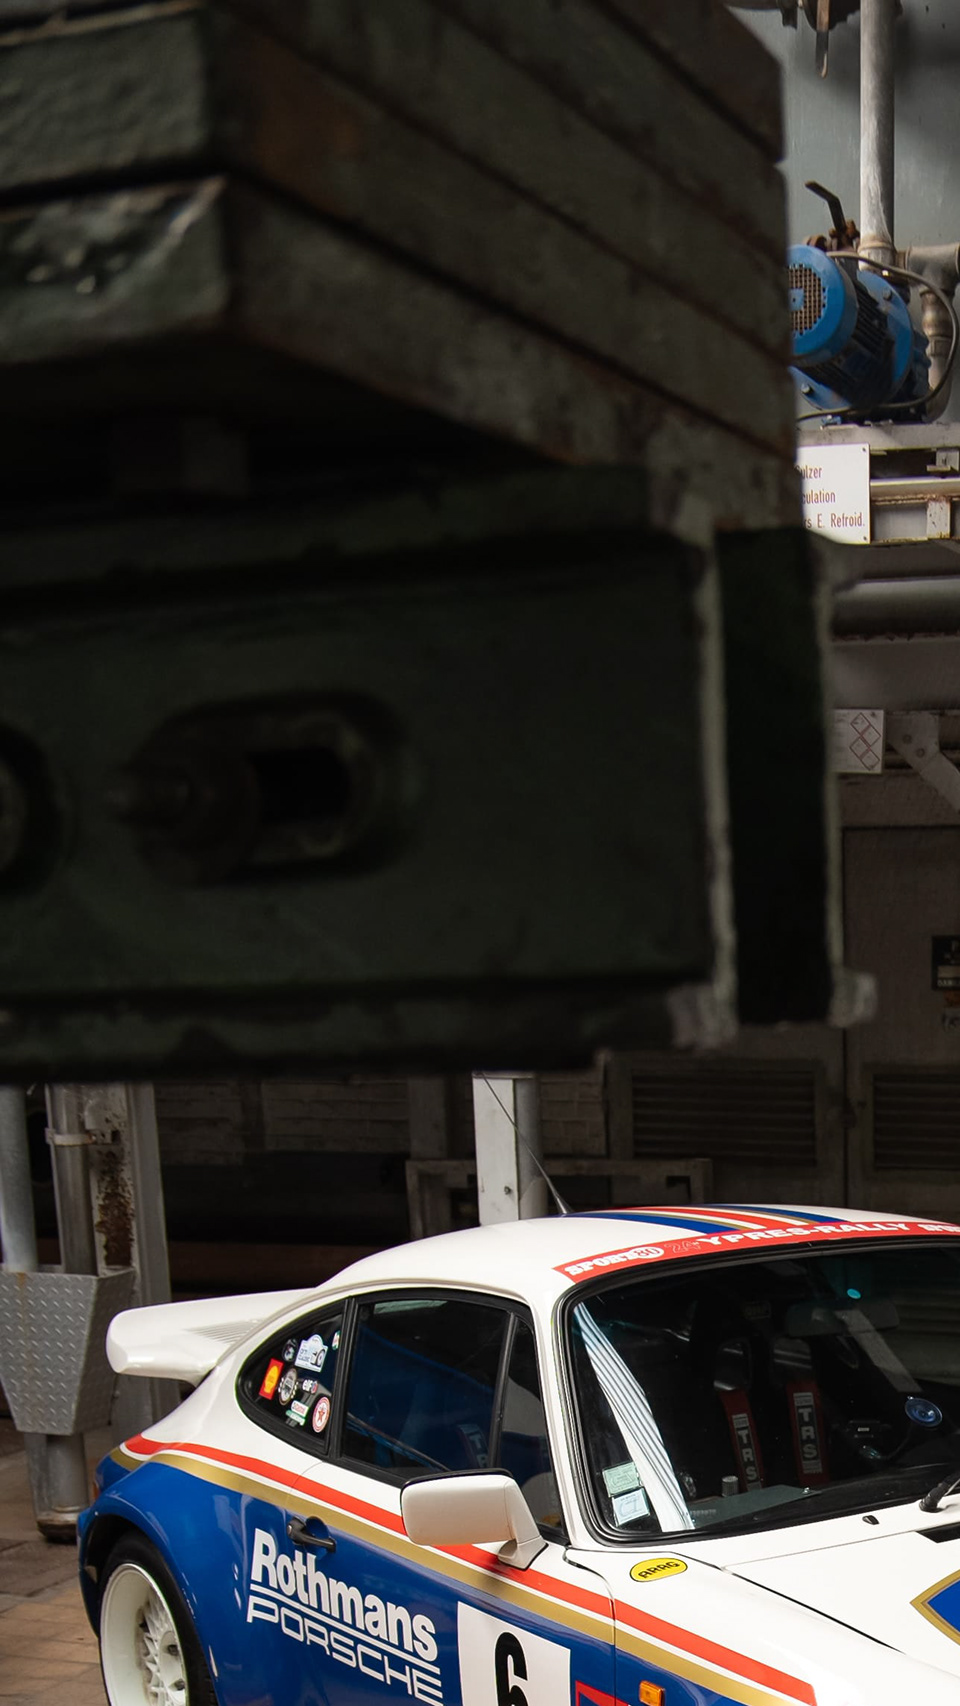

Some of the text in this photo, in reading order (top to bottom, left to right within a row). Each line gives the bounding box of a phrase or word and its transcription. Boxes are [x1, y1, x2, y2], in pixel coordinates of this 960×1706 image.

[830, 512, 866, 528] Refroid.
[697, 1222, 911, 1246] YPRES-RALLY
[637, 1558, 682, 1580] ARAG
[250, 1527, 439, 1663] Rothmans
